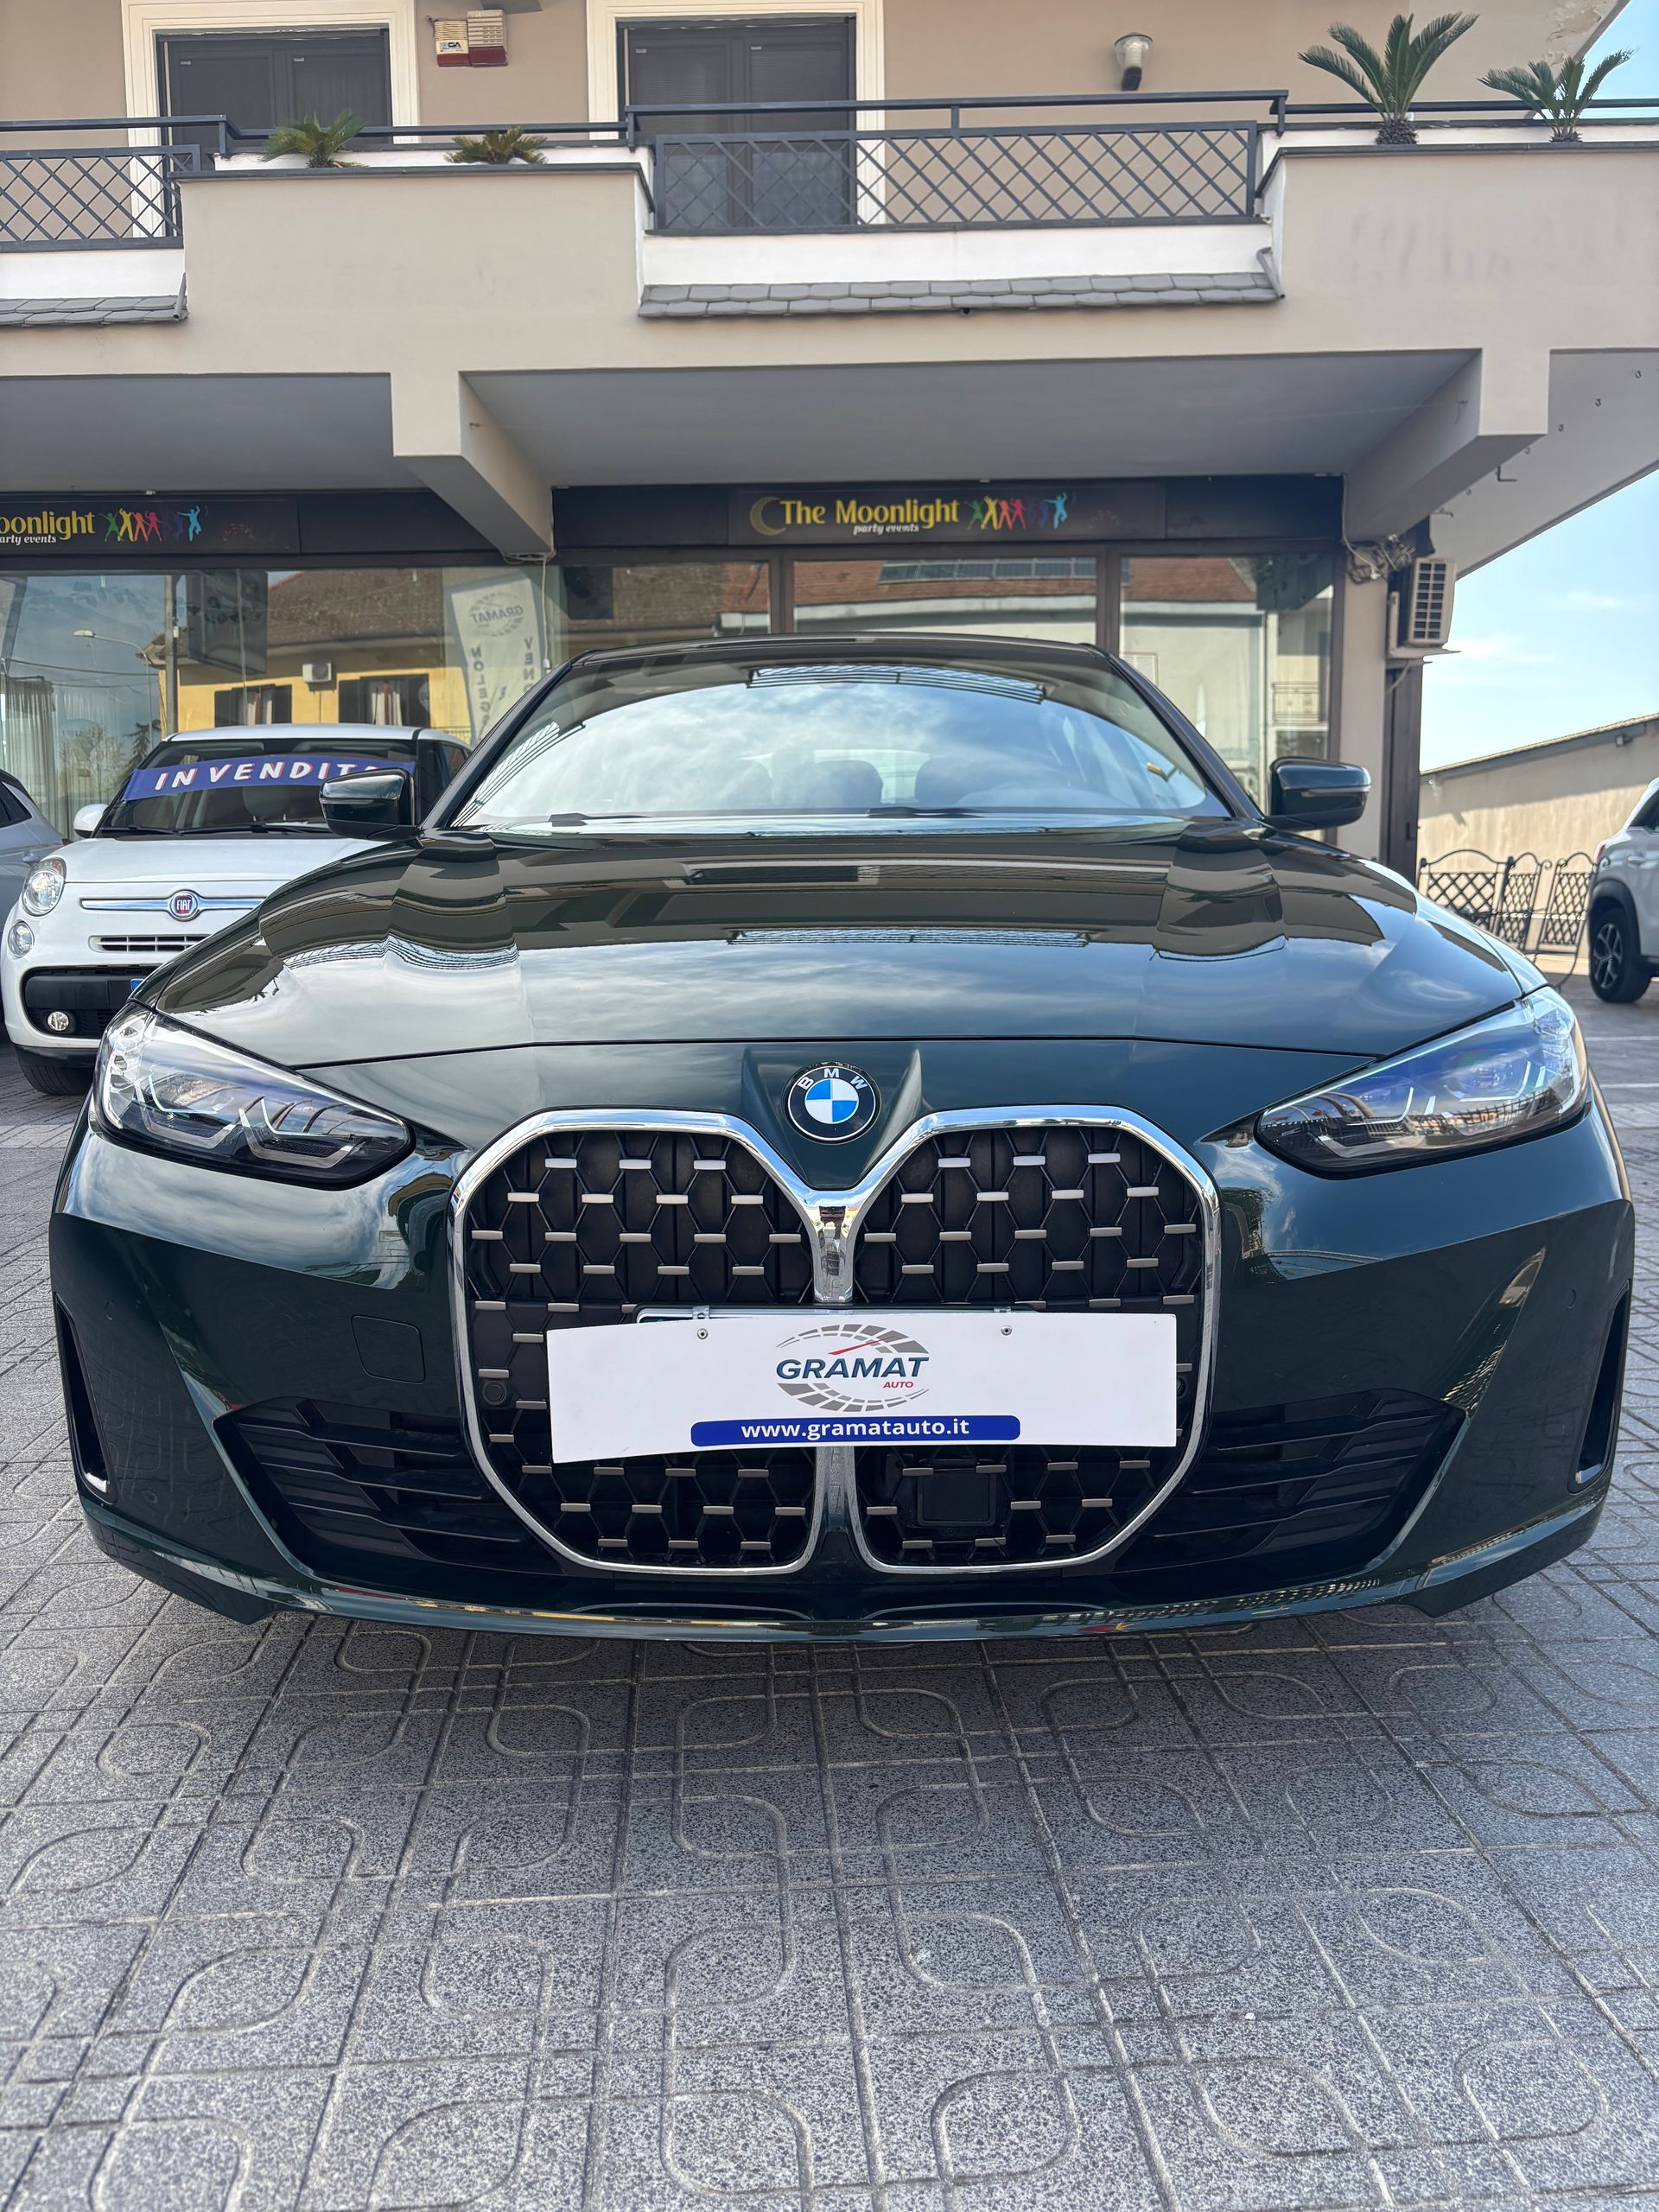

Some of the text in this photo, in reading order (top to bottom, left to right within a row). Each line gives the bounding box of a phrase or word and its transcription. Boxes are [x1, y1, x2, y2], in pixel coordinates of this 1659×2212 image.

[779, 498, 960, 530] The Moonlight
[23, 535, 57, 543] events
[853, 524, 919, 536] party events
[154, 761, 378, 791] IN VENDIT
[176, 899, 192, 911] FIAT
[797, 1067, 868, 1090] BMW
[776, 1357, 930, 1380] GRAMAT
[883, 1381, 914, 1389] AUTO
[741, 1418, 969, 1441] www.gramatauto.it
